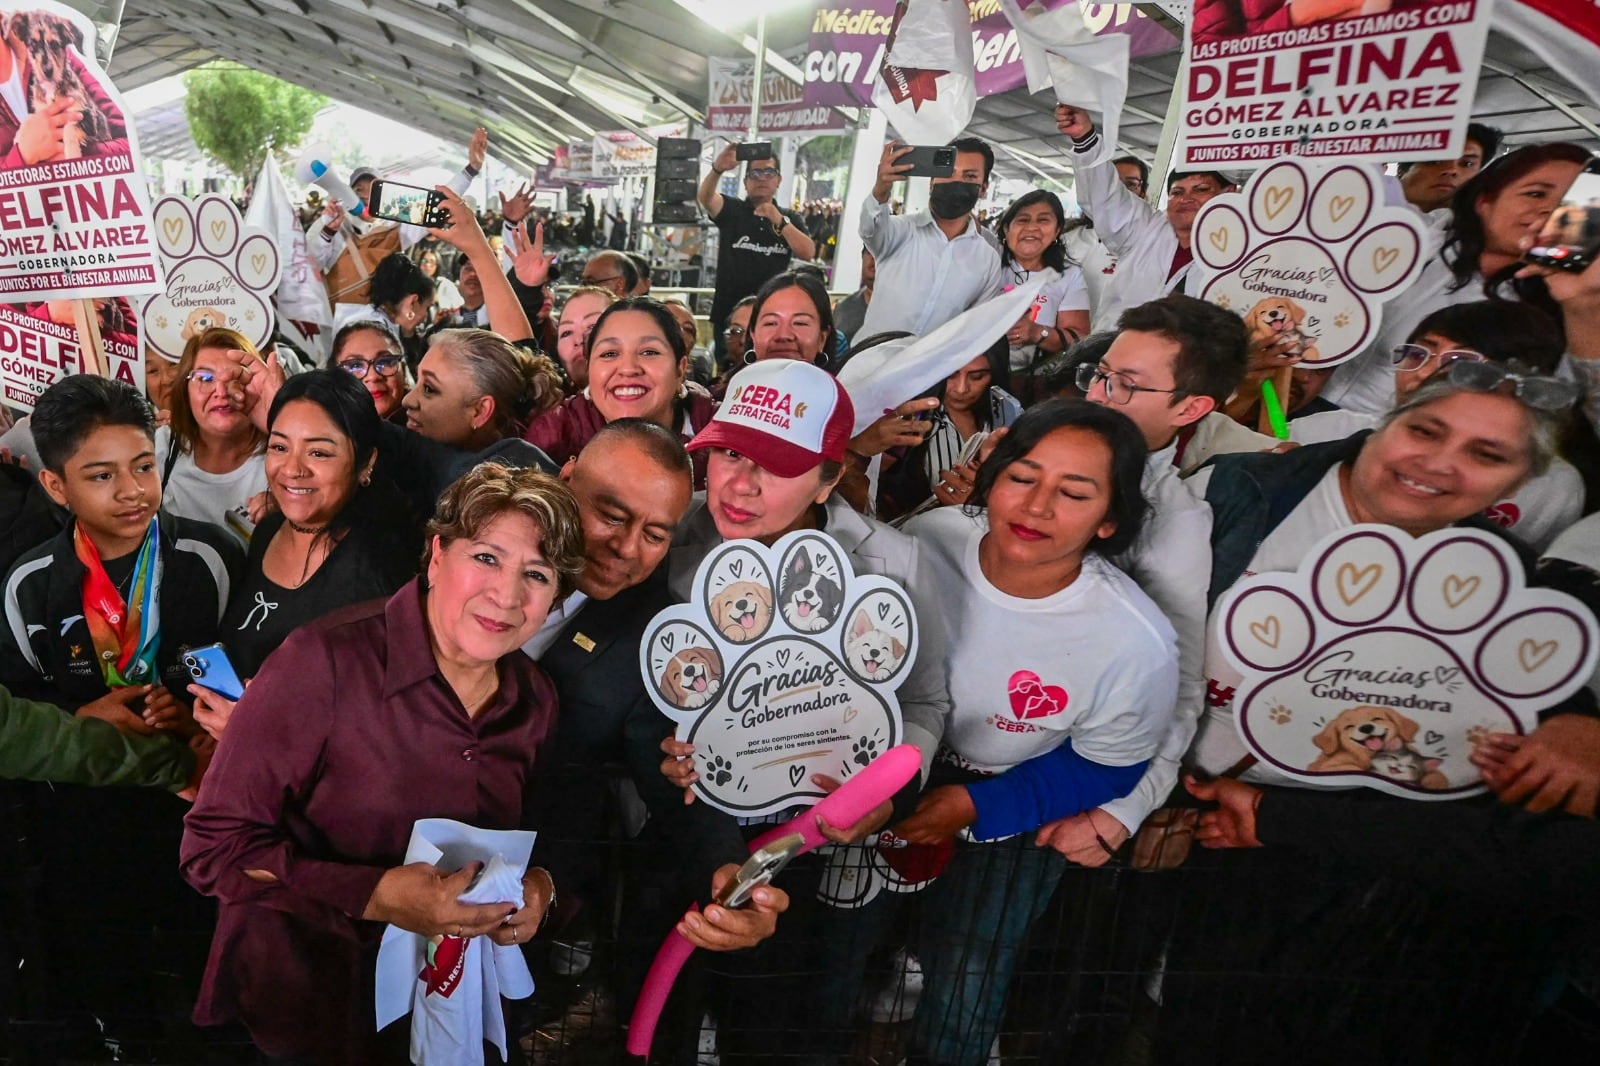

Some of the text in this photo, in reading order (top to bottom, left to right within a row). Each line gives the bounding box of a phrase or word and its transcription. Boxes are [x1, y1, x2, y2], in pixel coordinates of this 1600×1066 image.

[812, 8, 894, 36] ¡Médico
[1192, 1, 1471, 59] LAS PROTECTORAS ESTAMOS CON
[804, 50, 863, 83] con
[1187, 31, 1462, 102] DELFINA
[1186, 101, 1285, 127] GÓMEZ
[1231, 118, 1389, 139] GOBERNADORA
[1190, 133, 1443, 161] JUNTOS POR EL BIENESTAR ANIMAL
[54, 158, 103, 180] ESTAMOS
[105, 154, 130, 173] CON
[0, 178, 143, 231] ELFINA
[0, 225, 149, 257] ÓMEZ ALVAREZ
[19, 252, 116, 271] GOBERNADORA
[1239, 254, 1317, 284] Gracias
[0, 267, 153, 291] JUNTOS POR EL BIENESTAR ANIMAL
[166, 274, 224, 298] Gracias
[1243, 279, 1328, 303] Gobernadora
[171, 296, 236, 307] Gobernadora
[13, 311, 72, 340] PROTECTORAS
[115, 342, 136, 358] CON
[0, 324, 137, 387] DELFIA
[1, 357, 56, 385] GÓMEZ
[8, 387, 36, 406] JUNTOS
[740, 384, 792, 416] CERA
[728, 403, 791, 431] ESTRATEGIA
[1303, 650, 1433, 688] Gracias
[727, 660, 839, 713] Gracias
[1311, 683, 1453, 713] Gobernadora
[741, 690, 852, 729] Gobernadora
[748, 739, 760, 748] por
[771, 731, 815, 744] compromiso
[816, 729, 829, 737] con
[996, 720, 1036, 733] CERA
[736, 746, 773, 758] protección
[774, 743, 783, 751] de
[796, 739, 816, 748] seres
[438, 980, 451, 992] LA
